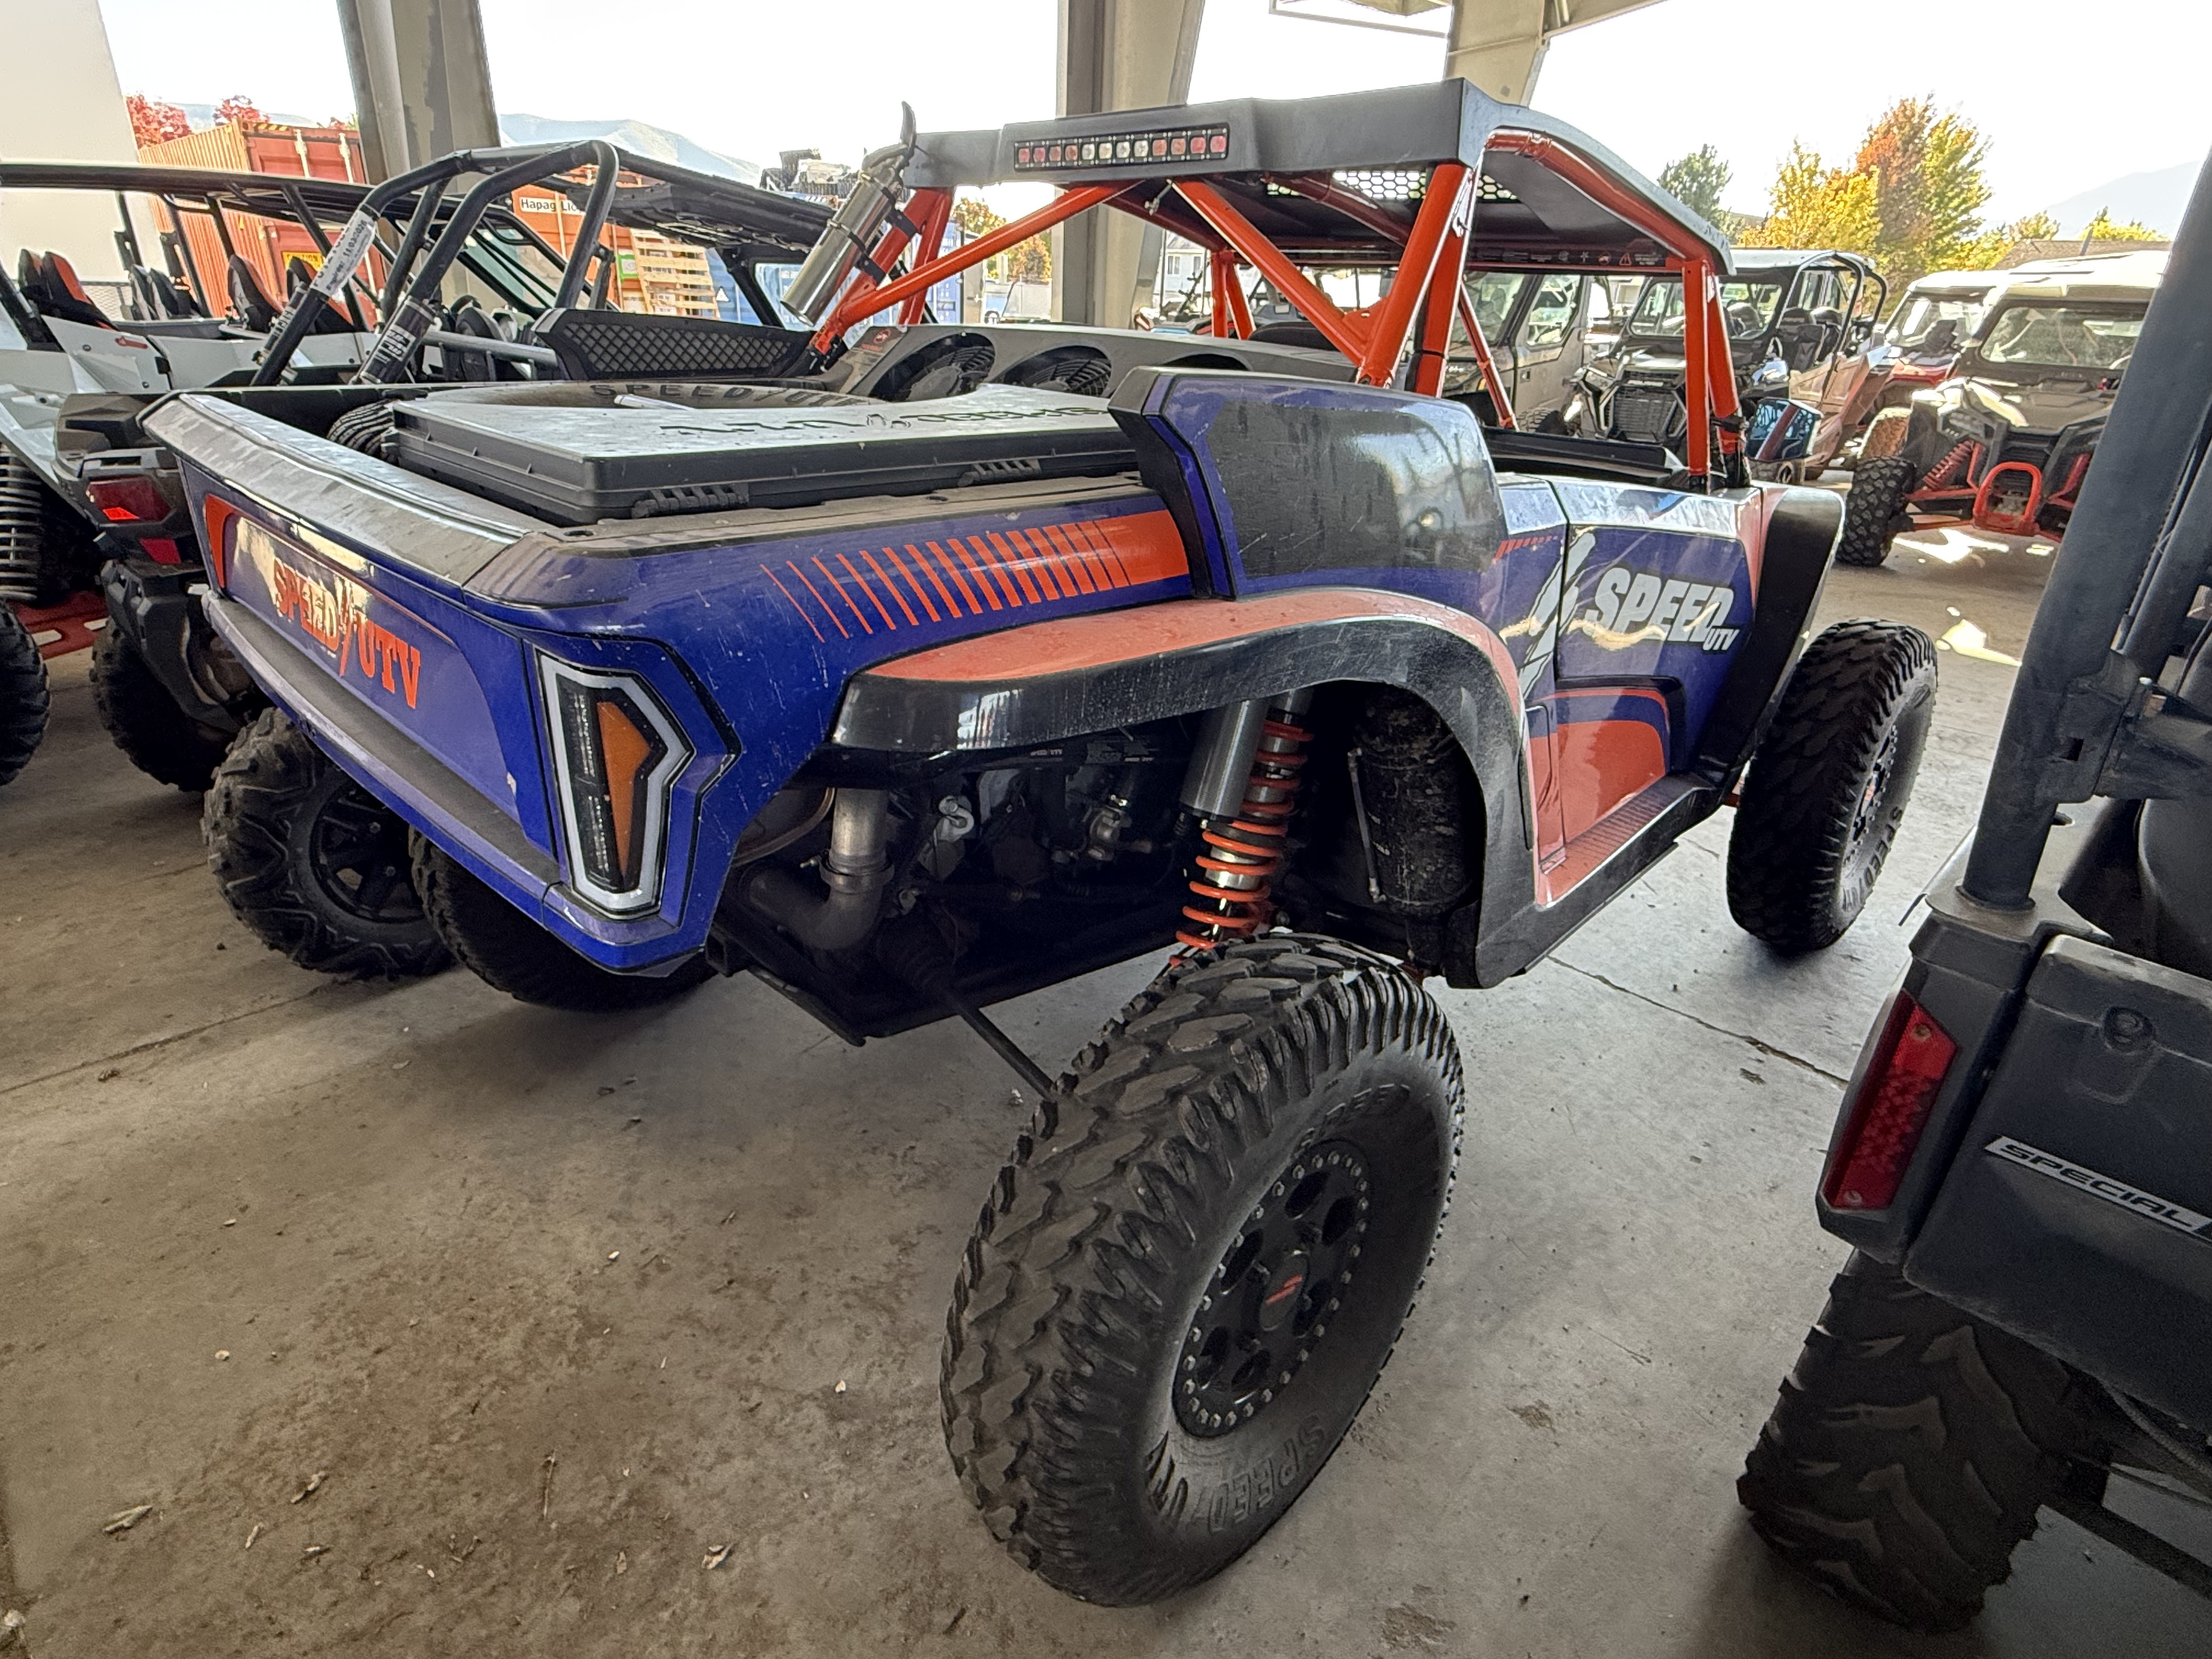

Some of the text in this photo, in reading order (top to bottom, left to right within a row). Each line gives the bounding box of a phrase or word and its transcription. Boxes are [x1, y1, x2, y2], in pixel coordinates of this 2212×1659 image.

[1582, 567, 1734, 642] SPEED
[1703, 628, 1740, 651] UTV
[2000, 1144, 2193, 1228] SPECIAL
